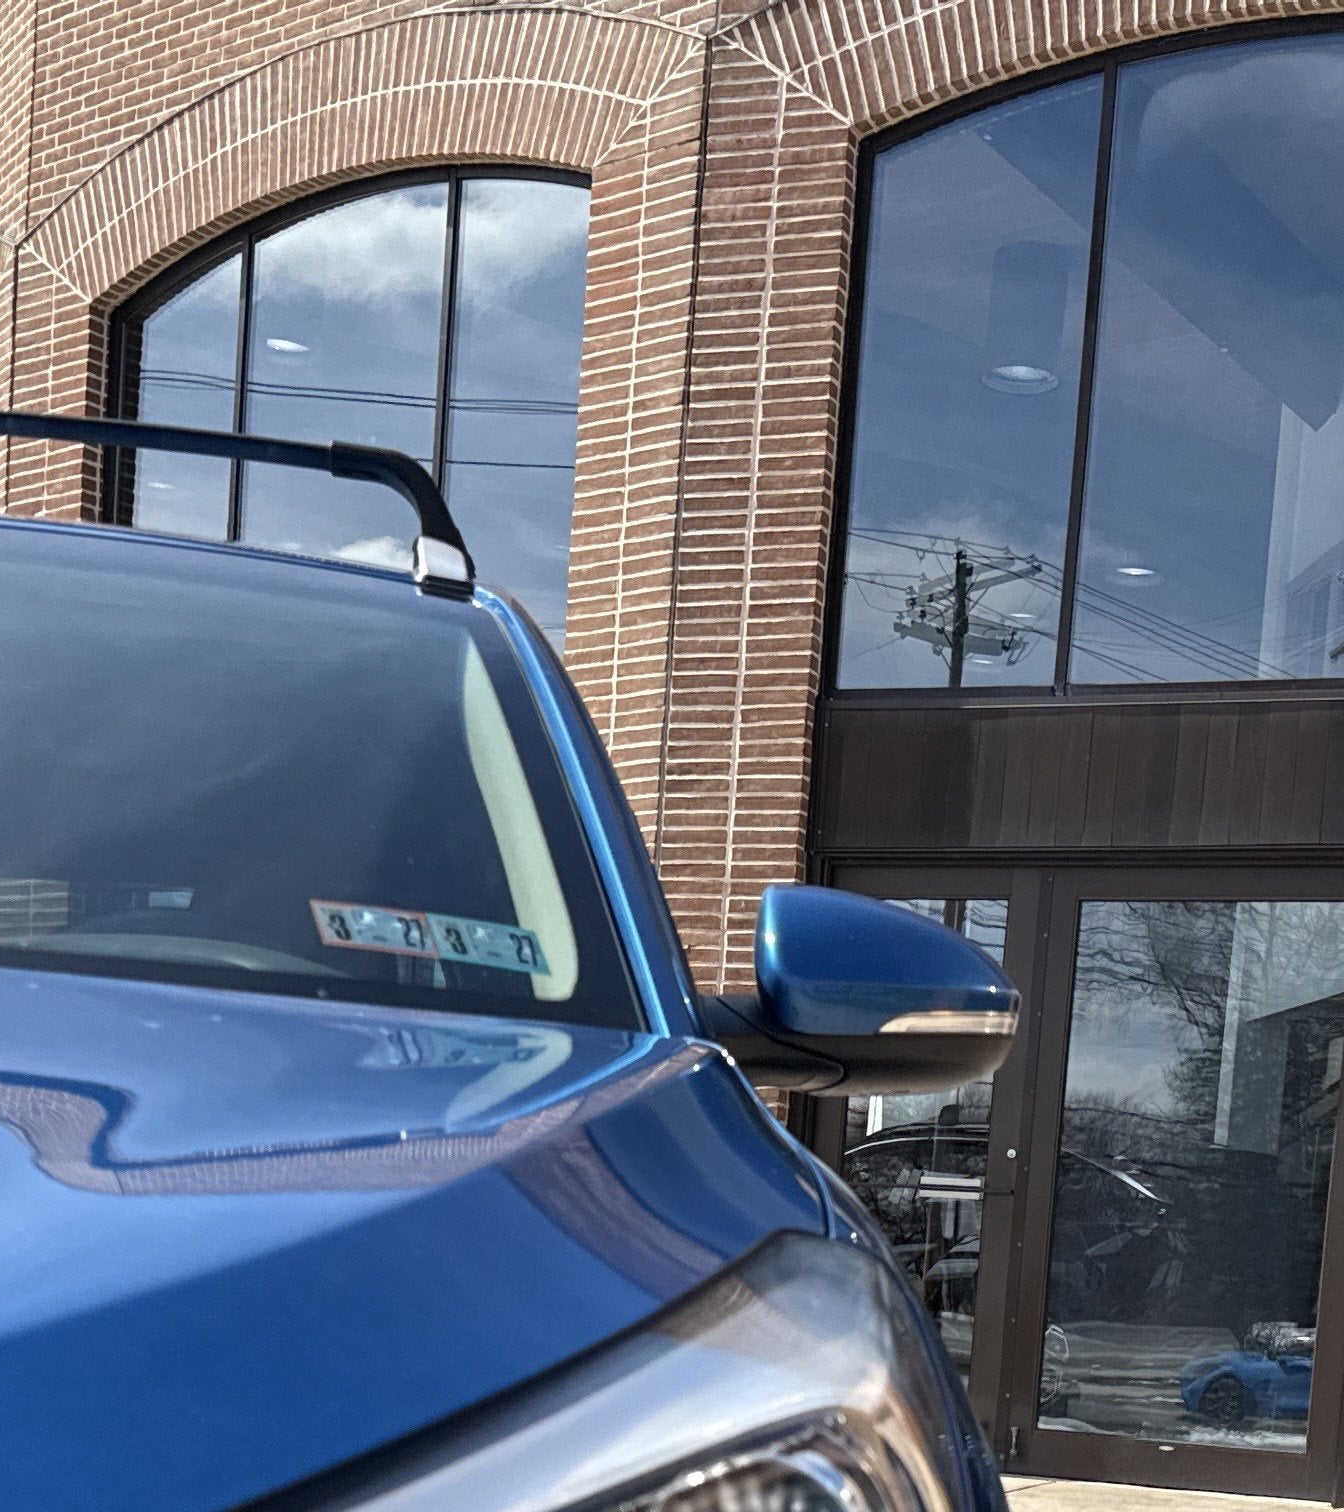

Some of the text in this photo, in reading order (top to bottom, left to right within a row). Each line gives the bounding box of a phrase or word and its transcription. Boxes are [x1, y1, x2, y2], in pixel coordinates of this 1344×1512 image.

[328, 913, 425, 950] 3 27
[444, 926, 537, 967] 3 27
